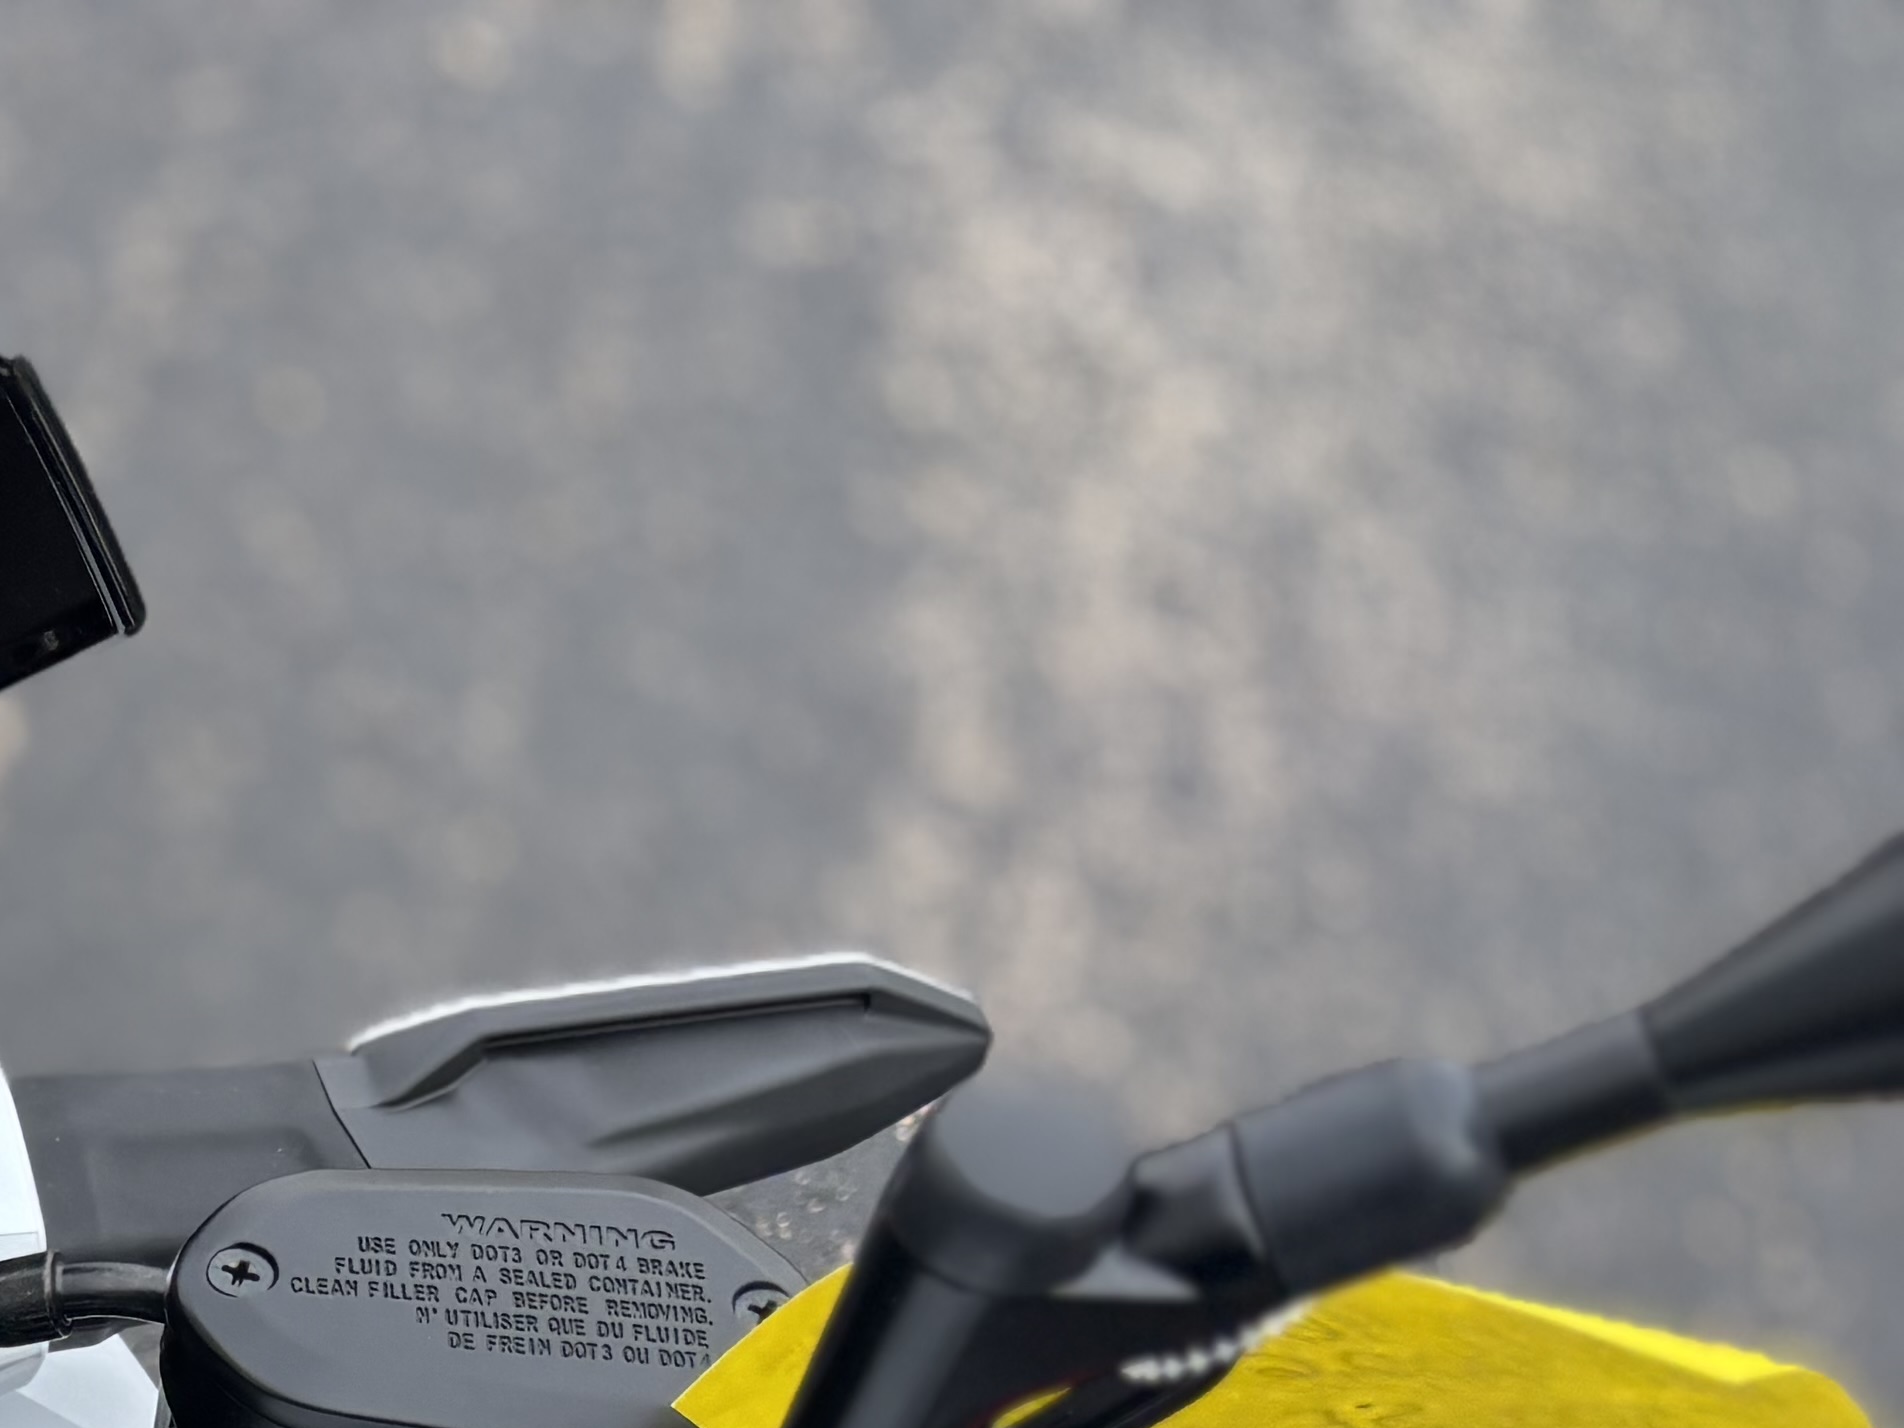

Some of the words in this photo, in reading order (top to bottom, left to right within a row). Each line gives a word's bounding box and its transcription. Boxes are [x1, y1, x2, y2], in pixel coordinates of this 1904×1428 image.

[441, 1213, 675, 1250] WARNING
[357, 1236, 396, 1255] USE
[408, 1239, 459, 1259] ONLY
[536, 1250, 564, 1267] OR
[637, 1257, 706, 1280] BRAKE
[290, 1276, 358, 1297] CLEAN
[367, 1281, 440, 1303] FILLER
[455, 1286, 497, 1306] CAP
[512, 1290, 589, 1315] BEFORE
[605, 1299, 713, 1326] REMOVING.
[334, 1257, 397, 1276] FLUID
[409, 1261, 462, 1281] FROM
[472, 1265, 488, 1283] A
[498, 1267, 577, 1290] SEALED
[588, 1275, 712, 1303] CONTAINER.
[444, 1308, 539, 1333] UTILISER
[548, 1316, 586, 1336] QUE
[596, 1320, 623, 1338] DU
[632, 1323, 710, 1349] FLUIDE
[448, 1331, 476, 1350] DE
[486, 1333, 551, 1356] FREIN
[623, 1346, 649, 1364] OU
